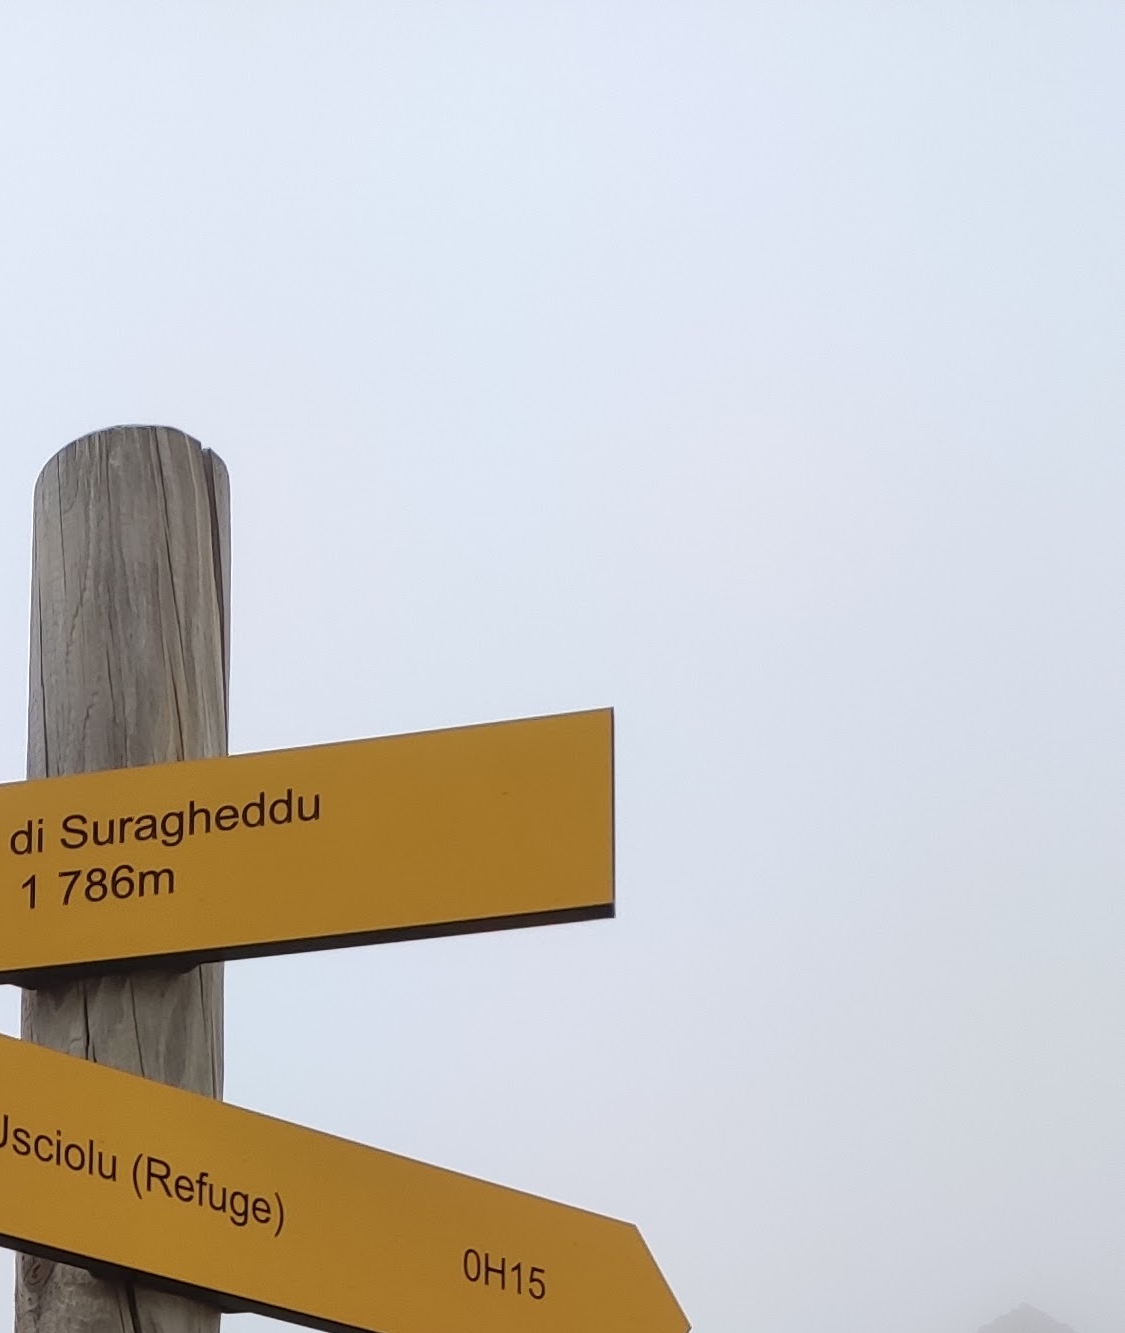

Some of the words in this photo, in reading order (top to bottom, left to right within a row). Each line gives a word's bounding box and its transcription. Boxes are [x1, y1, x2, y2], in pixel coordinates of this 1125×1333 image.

[10, 818, 44, 856] di
[59, 788, 321, 850] Suragheddu
[21, 874, 37, 910] 1
[58, 863, 175, 907] 786m
[132, 1152, 286, 1238] (Refuge)
[462, 1247, 547, 1301] 0H15
